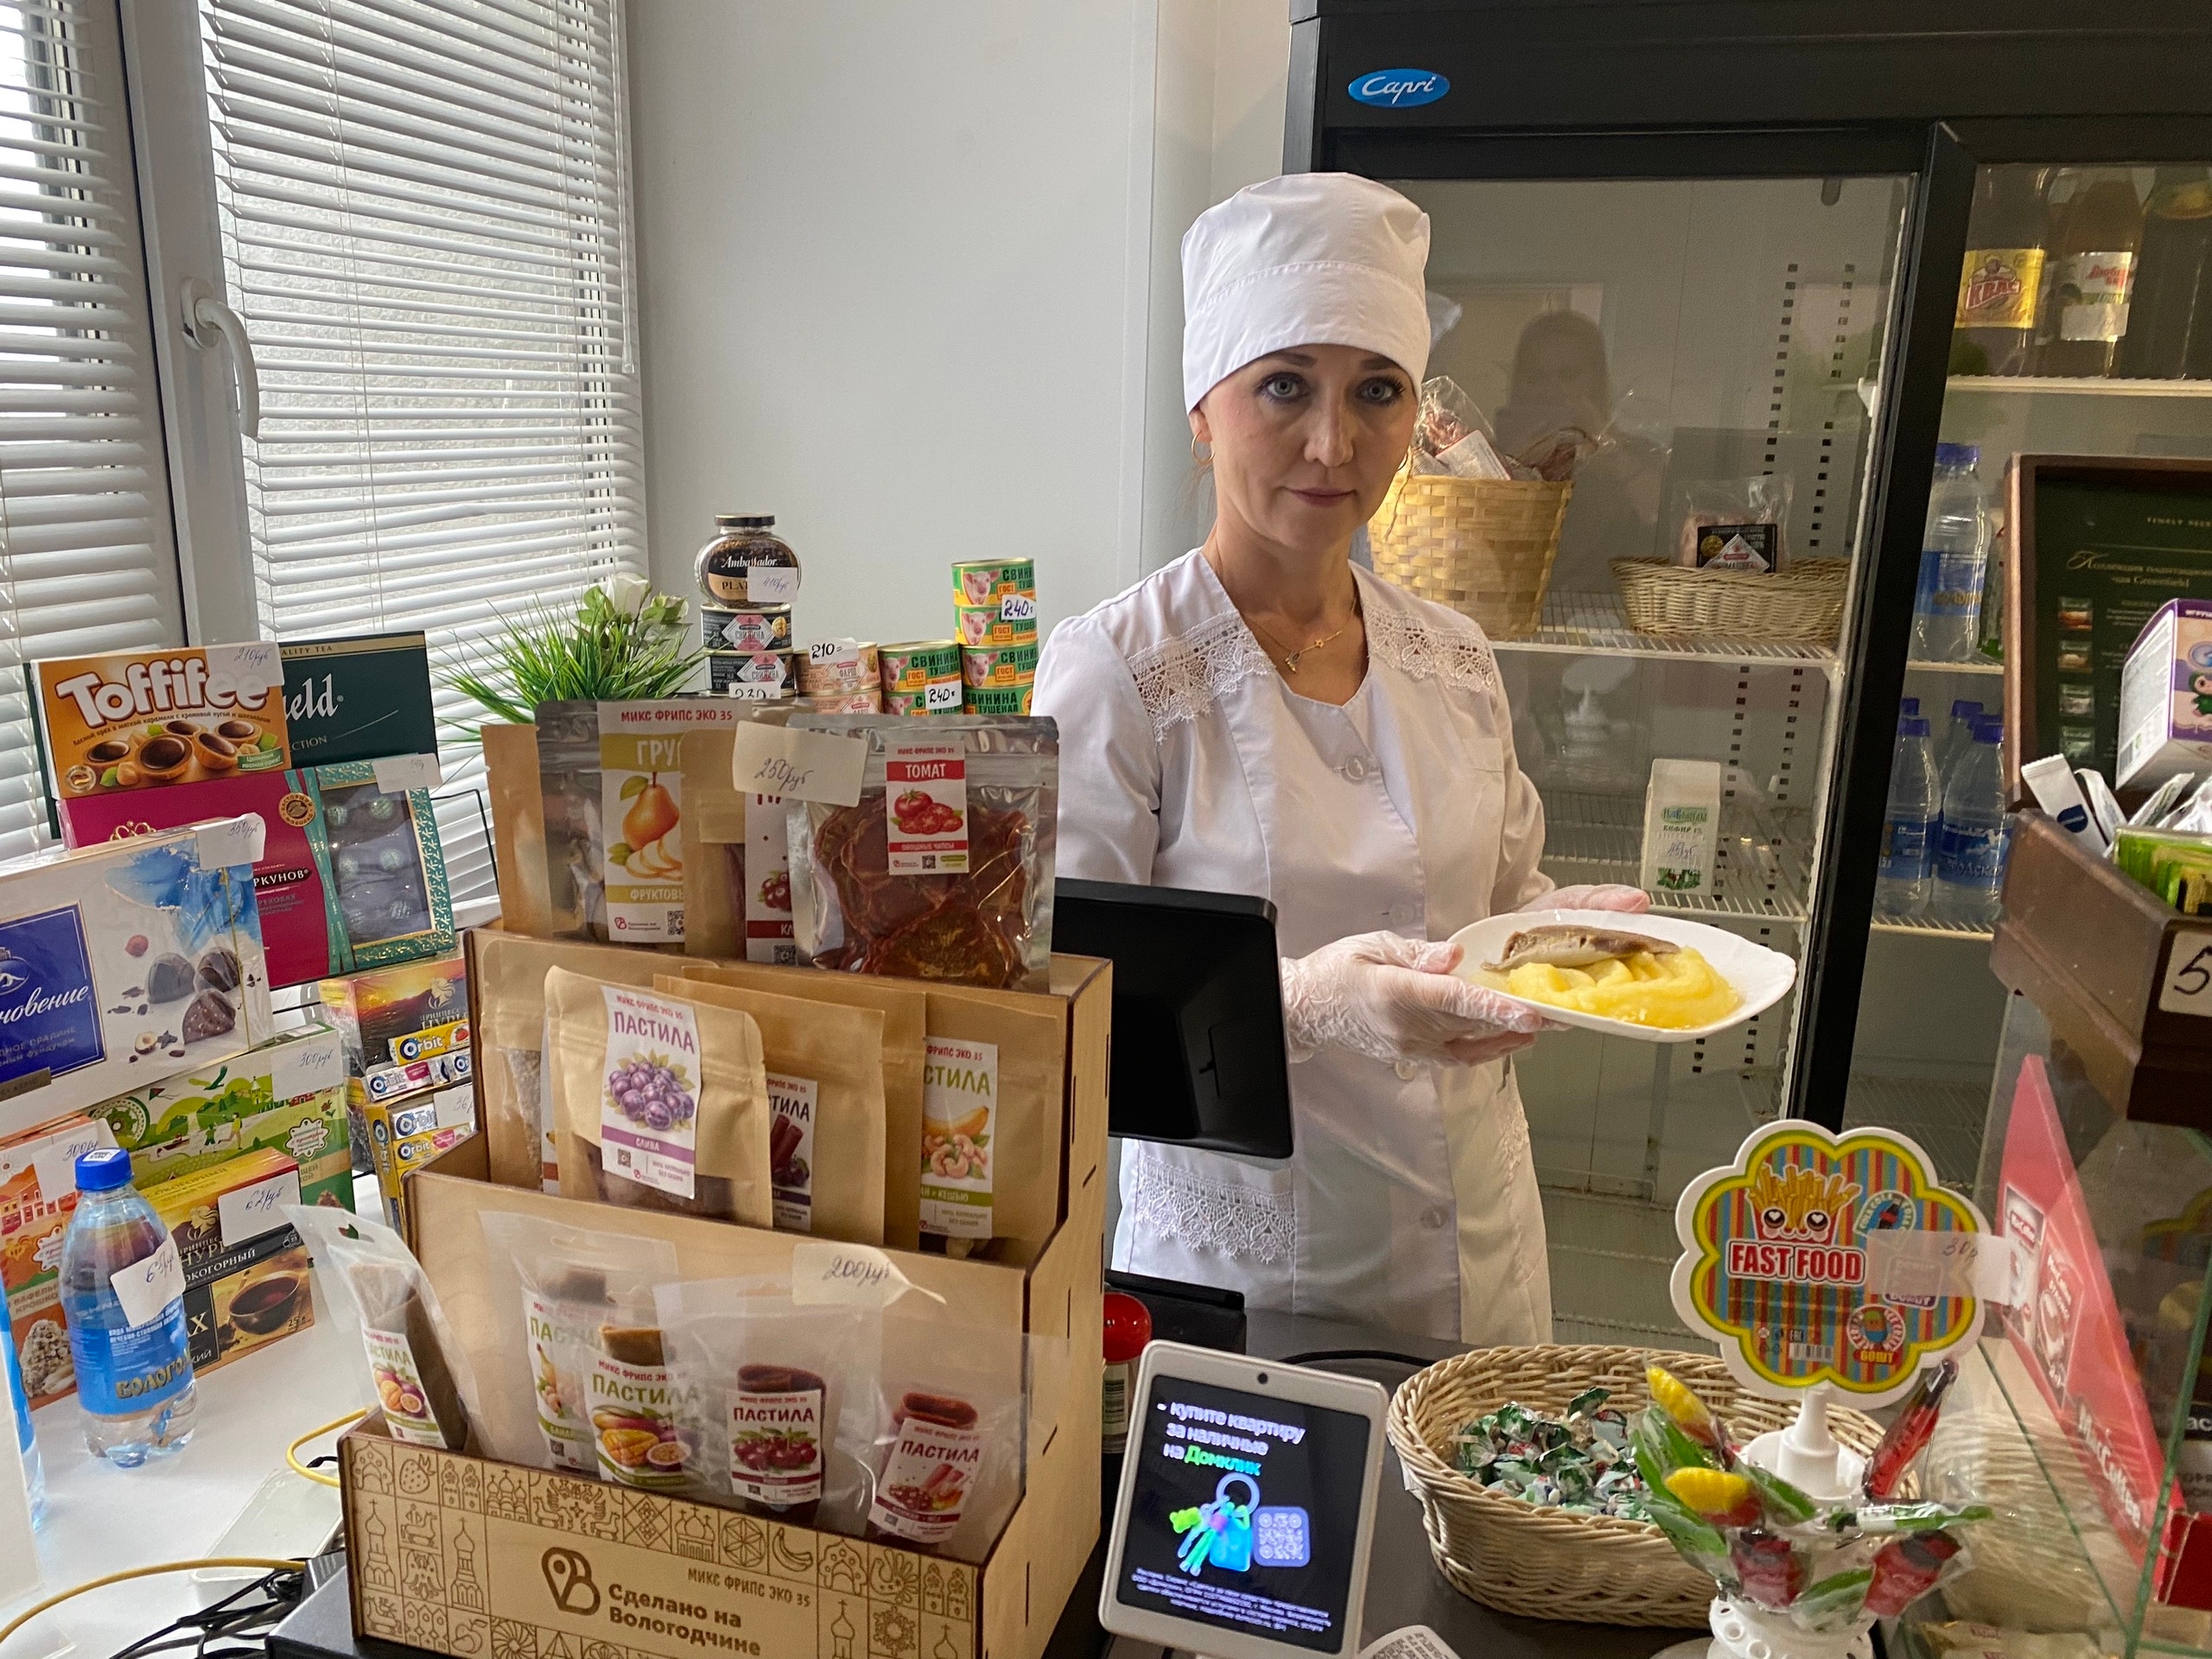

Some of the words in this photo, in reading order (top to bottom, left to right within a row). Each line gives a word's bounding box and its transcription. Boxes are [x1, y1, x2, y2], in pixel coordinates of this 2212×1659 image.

[1361, 75, 1437, 105] Capri
[721, 555, 779, 569] Ambassador
[314, 645, 333, 653] TEA
[907, 671, 925, 680] ГОСТ
[967, 692, 1018, 705] СВИНИНА
[143, 714, 175, 725] карамели
[181, 710, 211, 720] кремовой
[620, 709, 652, 722] МИКС
[654, 709, 693, 721] ФРИПС
[696, 709, 717, 721] ЭКО
[720, 710, 733, 721] 35
[905, 763, 946, 779] ТОМАТ
[613, 1010, 695, 1054] ПАСТИЛА
[403, 1034, 444, 1058] Orbit
[956, 1048, 972, 1060] ЭКО
[372, 1071, 406, 1090] Orbit
[924, 1065, 991, 1096] СТИЛА
[399, 1140, 430, 1158] Orbit
[635, 1137, 660, 1153] СЛИВА
[1731, 1243, 1793, 1277] FAST
[1795, 1248, 1863, 1282] FOOD
[598, 1359, 621, 1376] МИКС
[621, 1369, 653, 1382] ФРИПС
[592, 1372, 700, 1406] ПАСТИЛА
[733, 1407, 815, 1423] ПАСТИЛА
[1166, 1422, 1186, 1440] за
[1186, 1427, 1269, 1456] наличные
[1227, 1413, 1306, 1446] квартиру
[899, 1440, 980, 1463] ПАСТИЛА
[1162, 1443, 1185, 1460] на
[687, 1567, 721, 1587] МИКС
[723, 1574, 766, 1599] ФРИПС
[768, 1585, 793, 1604] ЭКО
[796, 1592, 811, 1608] 35
[607, 1582, 708, 1621] Сделано
[714, 1608, 742, 1629] на
[608, 1605, 761, 1657] Вологодчине
